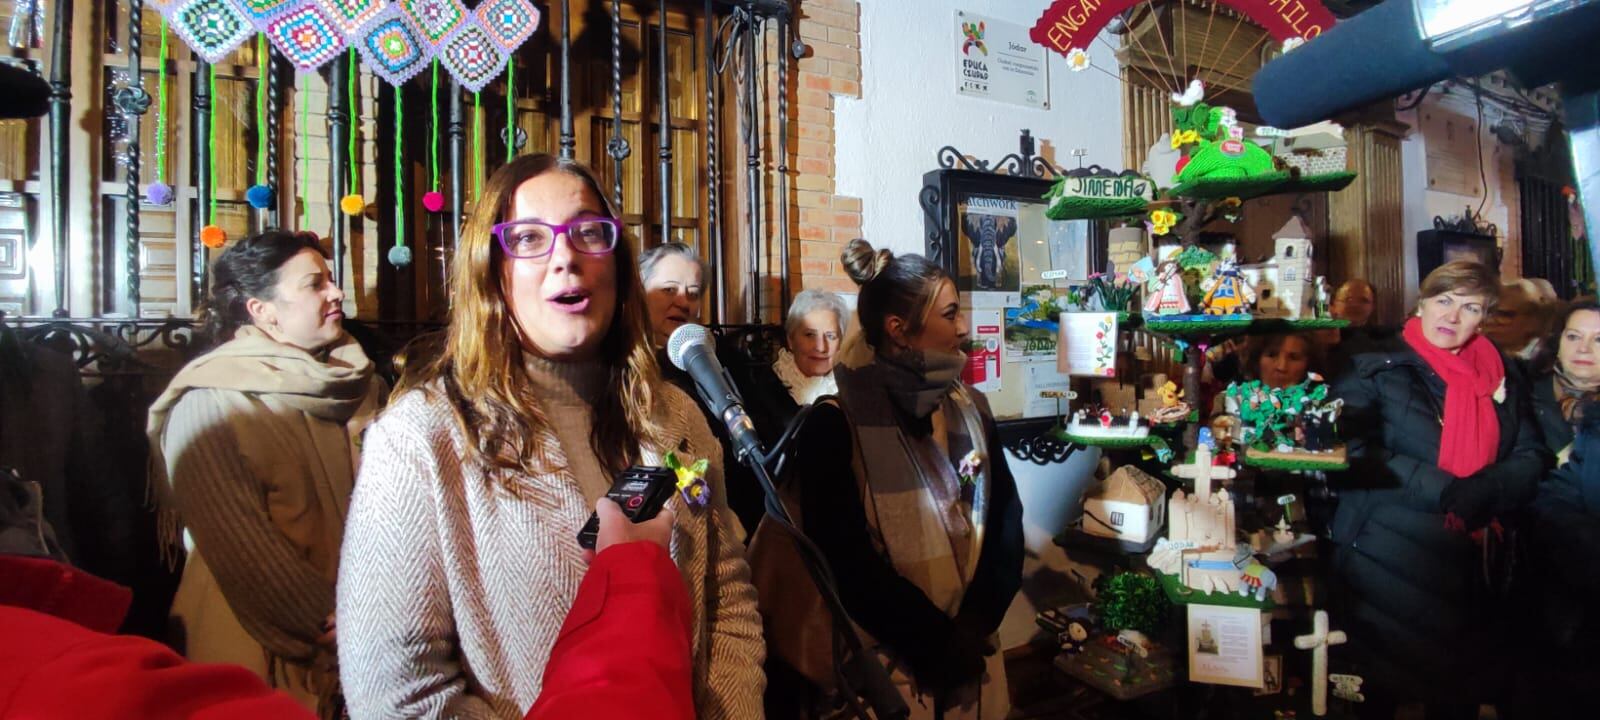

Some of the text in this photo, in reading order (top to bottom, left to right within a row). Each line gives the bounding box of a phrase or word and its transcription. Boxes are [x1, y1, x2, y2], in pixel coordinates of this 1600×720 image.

[1047, 0, 1101, 52] ENGA
[963, 59, 988, 72] EDUCA
[1072, 177, 1133, 198] JIMENA
